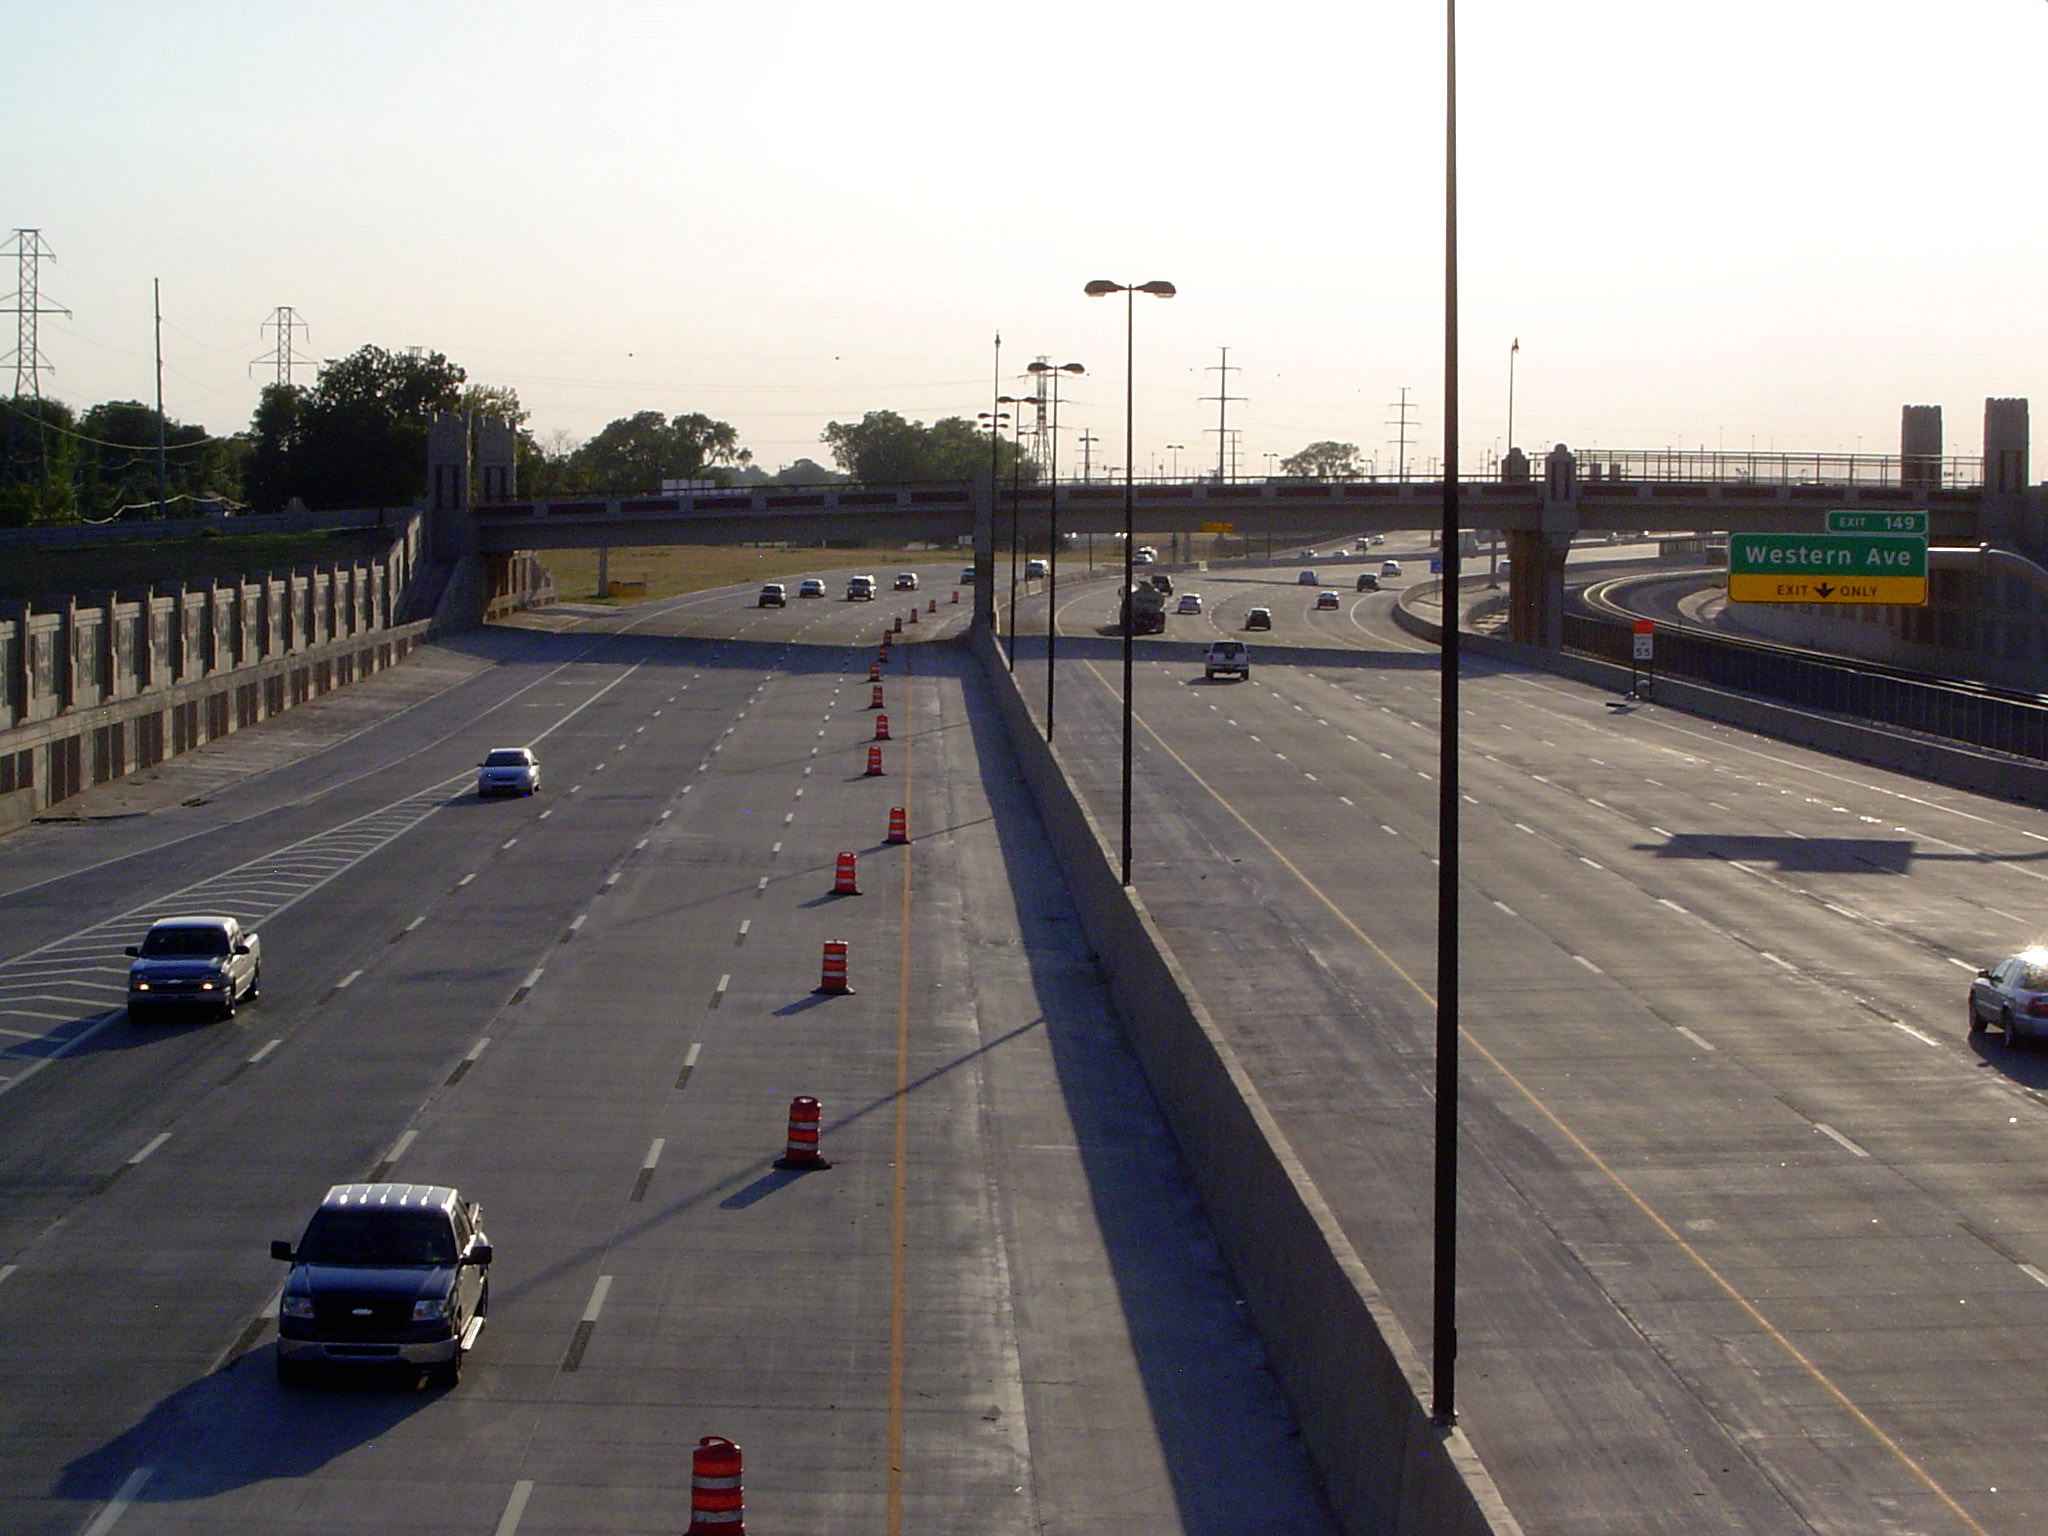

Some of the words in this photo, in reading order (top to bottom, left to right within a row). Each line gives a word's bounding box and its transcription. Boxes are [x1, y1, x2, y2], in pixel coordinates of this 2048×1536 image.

[1839, 517, 1866, 528] EXIT
[1885, 516, 1915, 530] 149
[1745, 545, 1851, 564] Western
[1866, 548, 1911, 566] Ave
[1777, 585, 1808, 596] EXIT
[1840, 585, 1878, 597] ONLY
